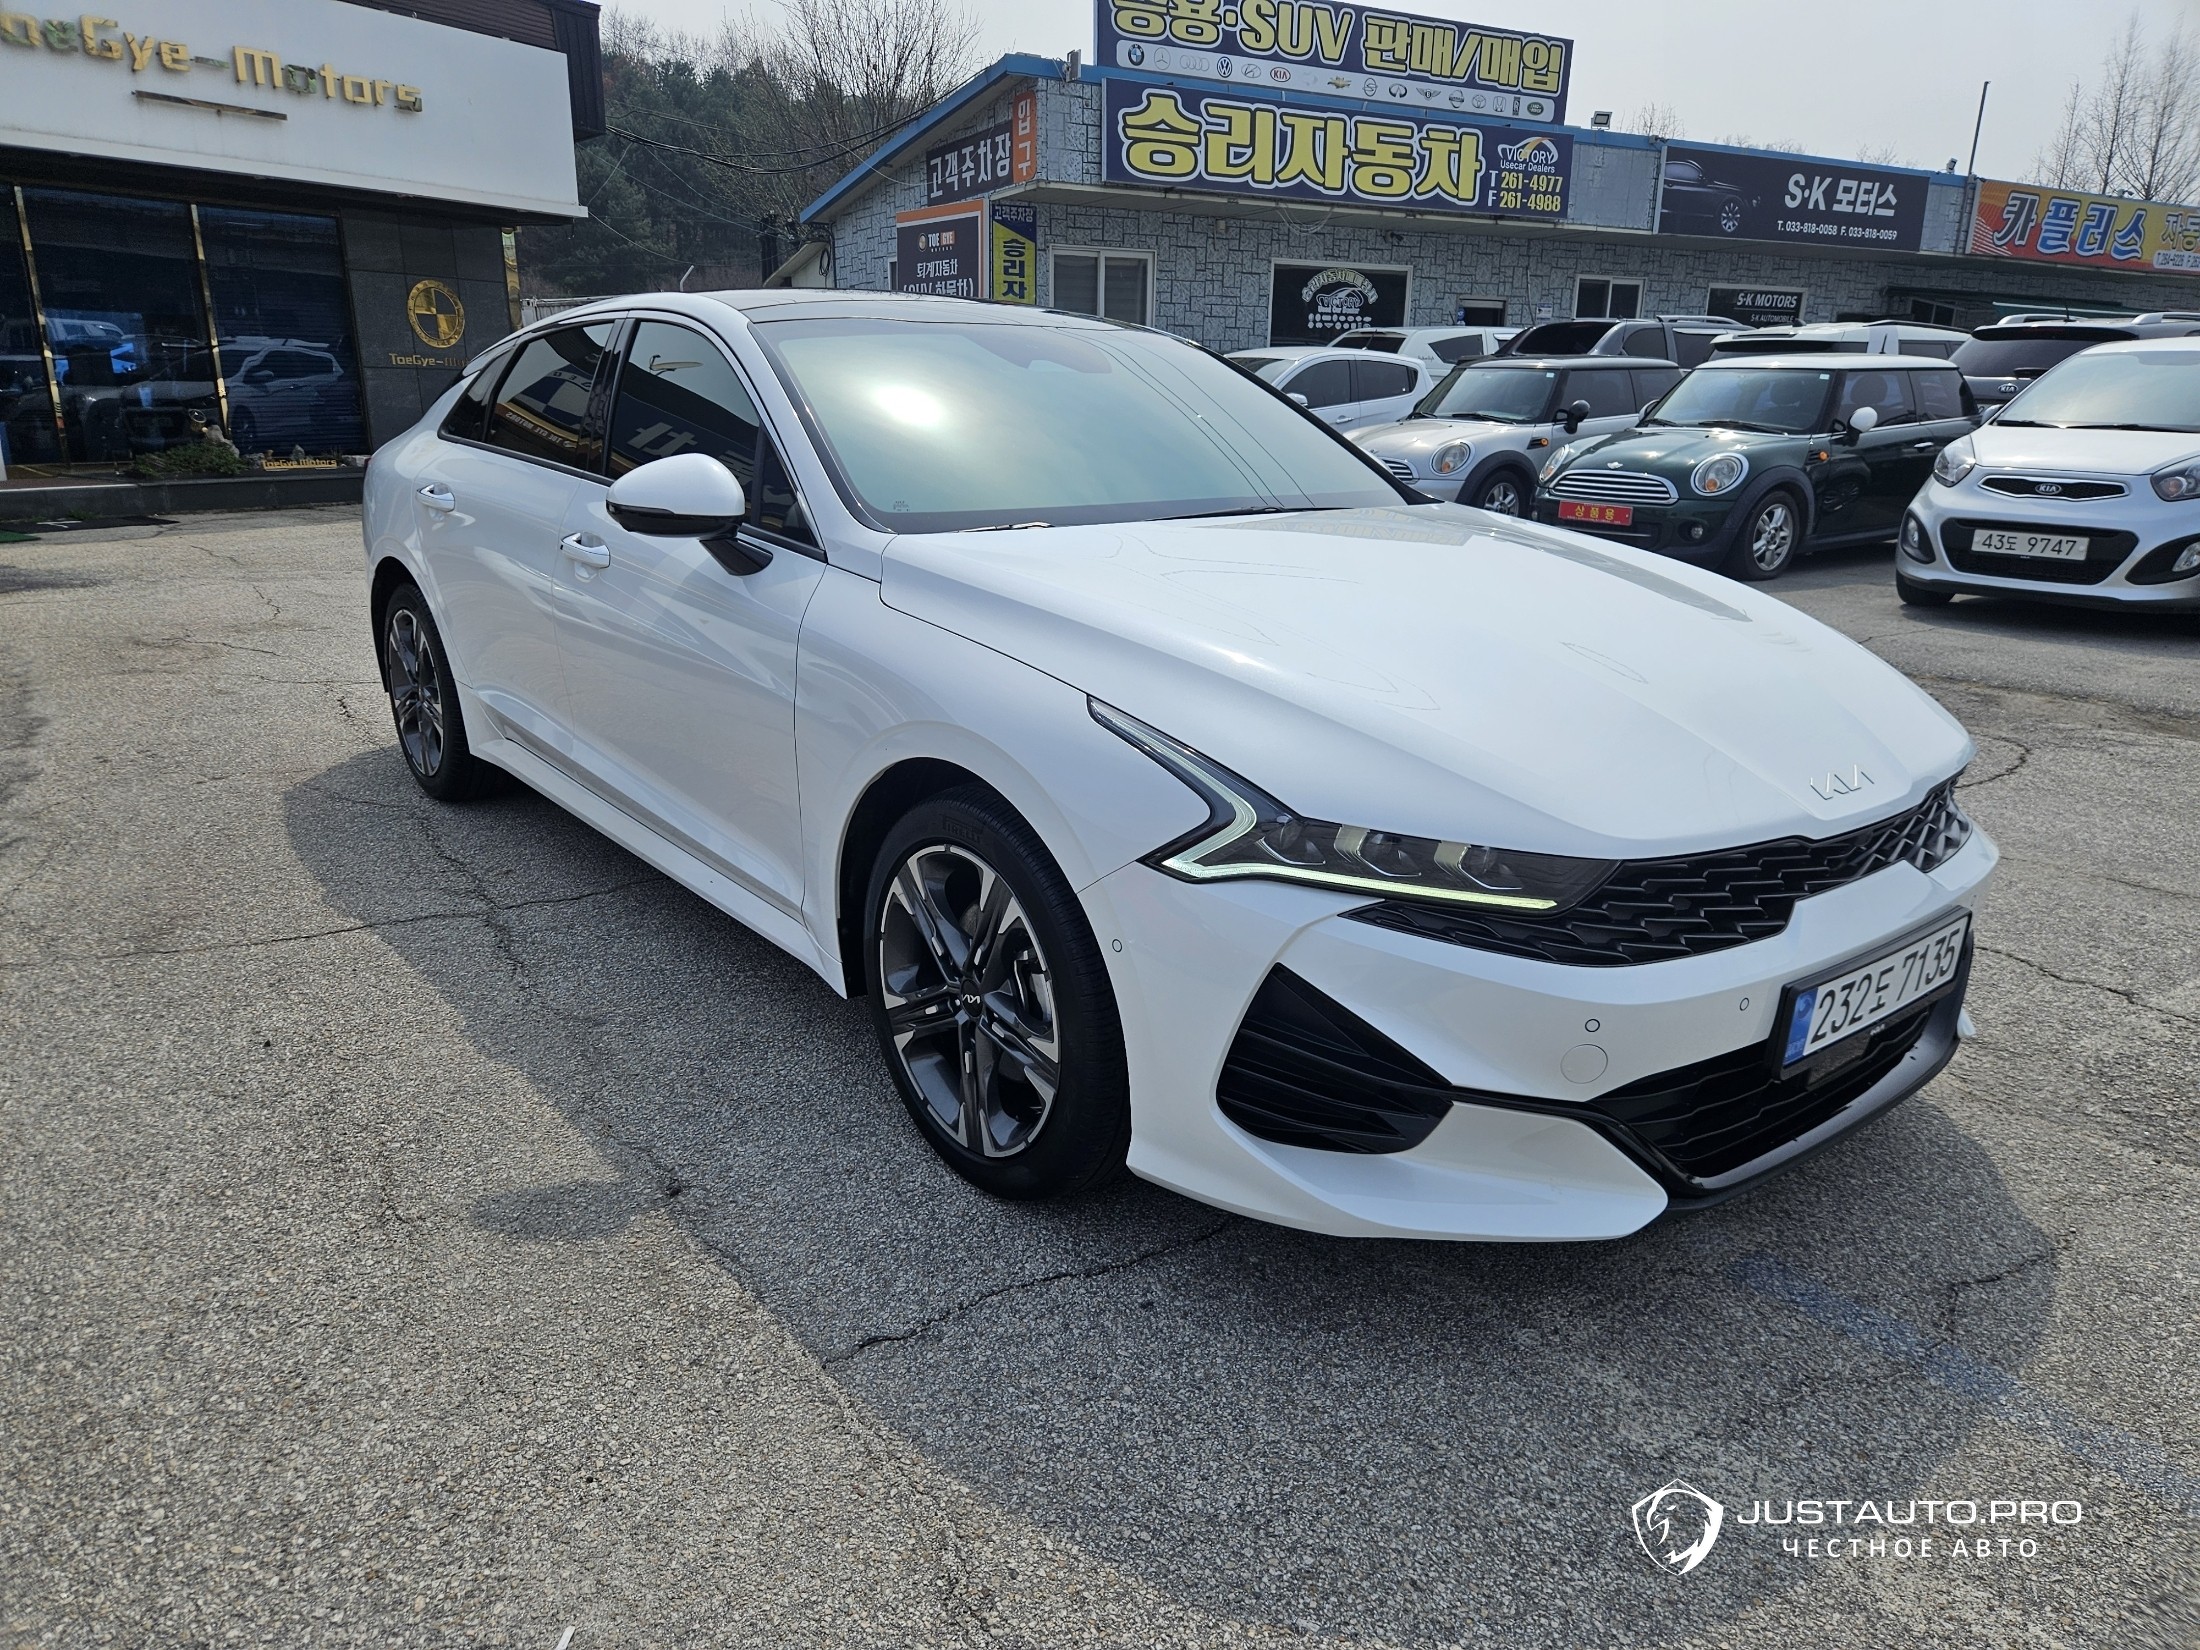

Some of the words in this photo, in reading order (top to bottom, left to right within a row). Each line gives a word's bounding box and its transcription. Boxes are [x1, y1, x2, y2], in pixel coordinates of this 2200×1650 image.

[1364, 15, 1564, 94] 판매/매입
[1018, 99, 1031, 176] 입구
[1121, 95, 1482, 202] 승리자동차
[1507, 147, 1553, 164] VICTORY
[929, 132, 1012, 198] 고객주차장
[1500, 160, 1526, 170] Usecar
[1528, 162, 1555, 173] Dealers
[1489, 170, 1498, 187] T
[1501, 171, 1563, 192] 261-4977
[1488, 190, 1497, 206] F
[1500, 191, 1561, 212] 261-4988
[1832, 179, 1898, 217] 모터스
[994, 205, 1033, 222] 고객주차장
[928, 233, 940, 247] TOE
[917, 259, 958, 278] 퇴계자동차
[1755, 294, 1797, 308] MOTORS
[2039, 483, 2056, 493] KIA
[2027, 537, 2077, 556] 9747
[1897, 928, 1960, 1001] 7135
